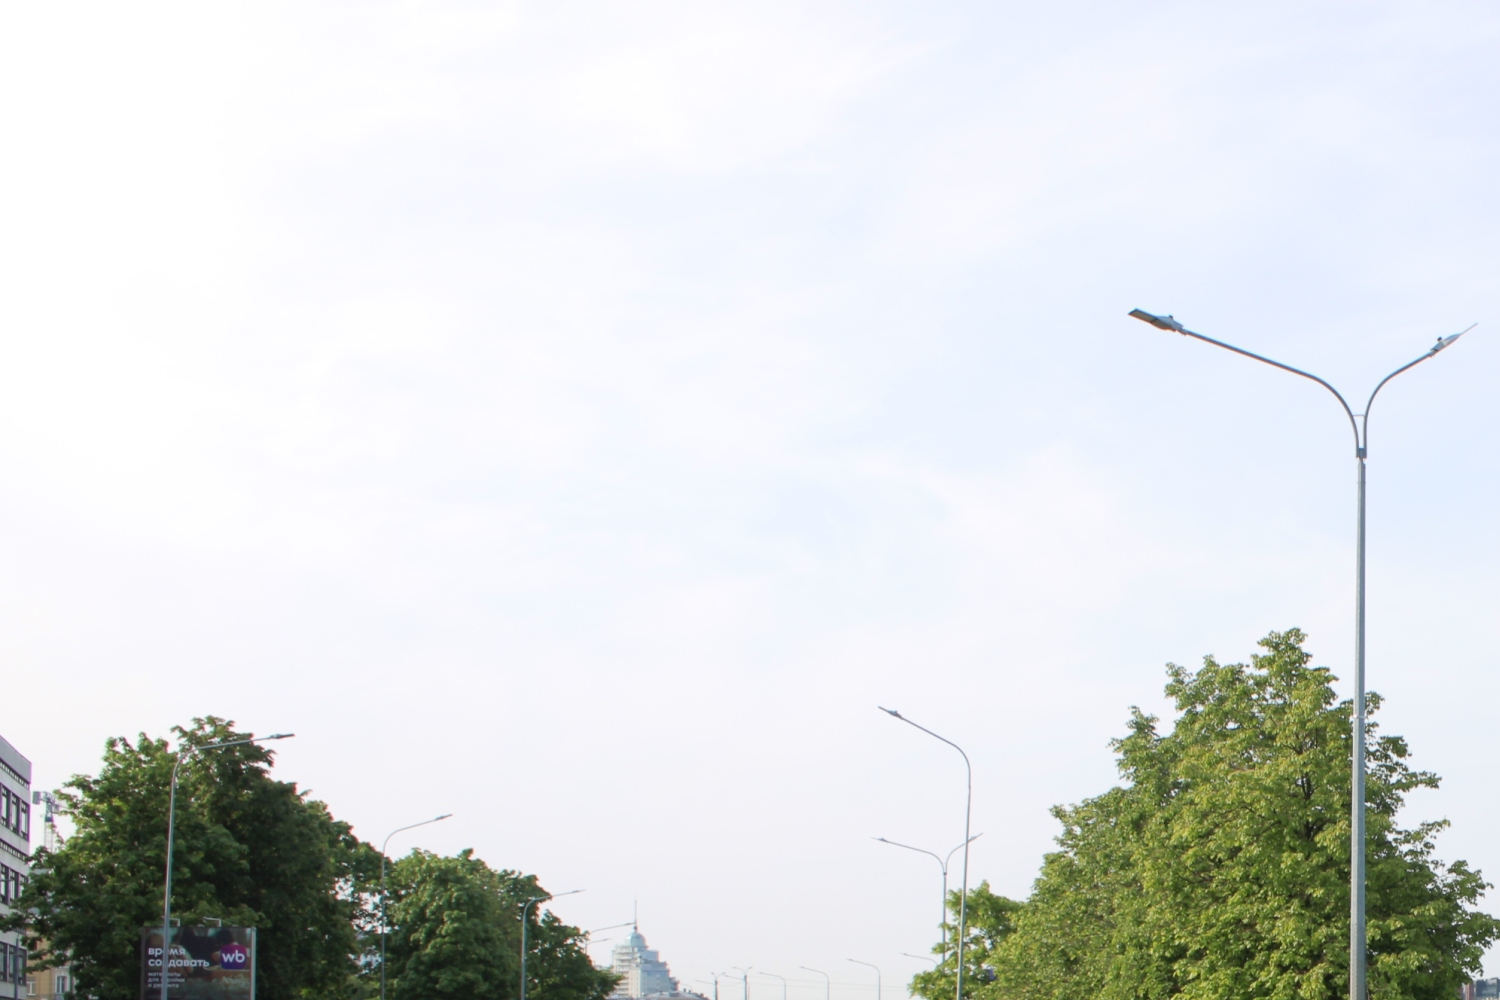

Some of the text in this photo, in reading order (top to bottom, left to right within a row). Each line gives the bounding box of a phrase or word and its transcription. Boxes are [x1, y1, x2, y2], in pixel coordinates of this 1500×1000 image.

[148, 947, 186, 957] врмя
[222, 950, 245, 963] wb
[148, 959, 210, 968] содавать
